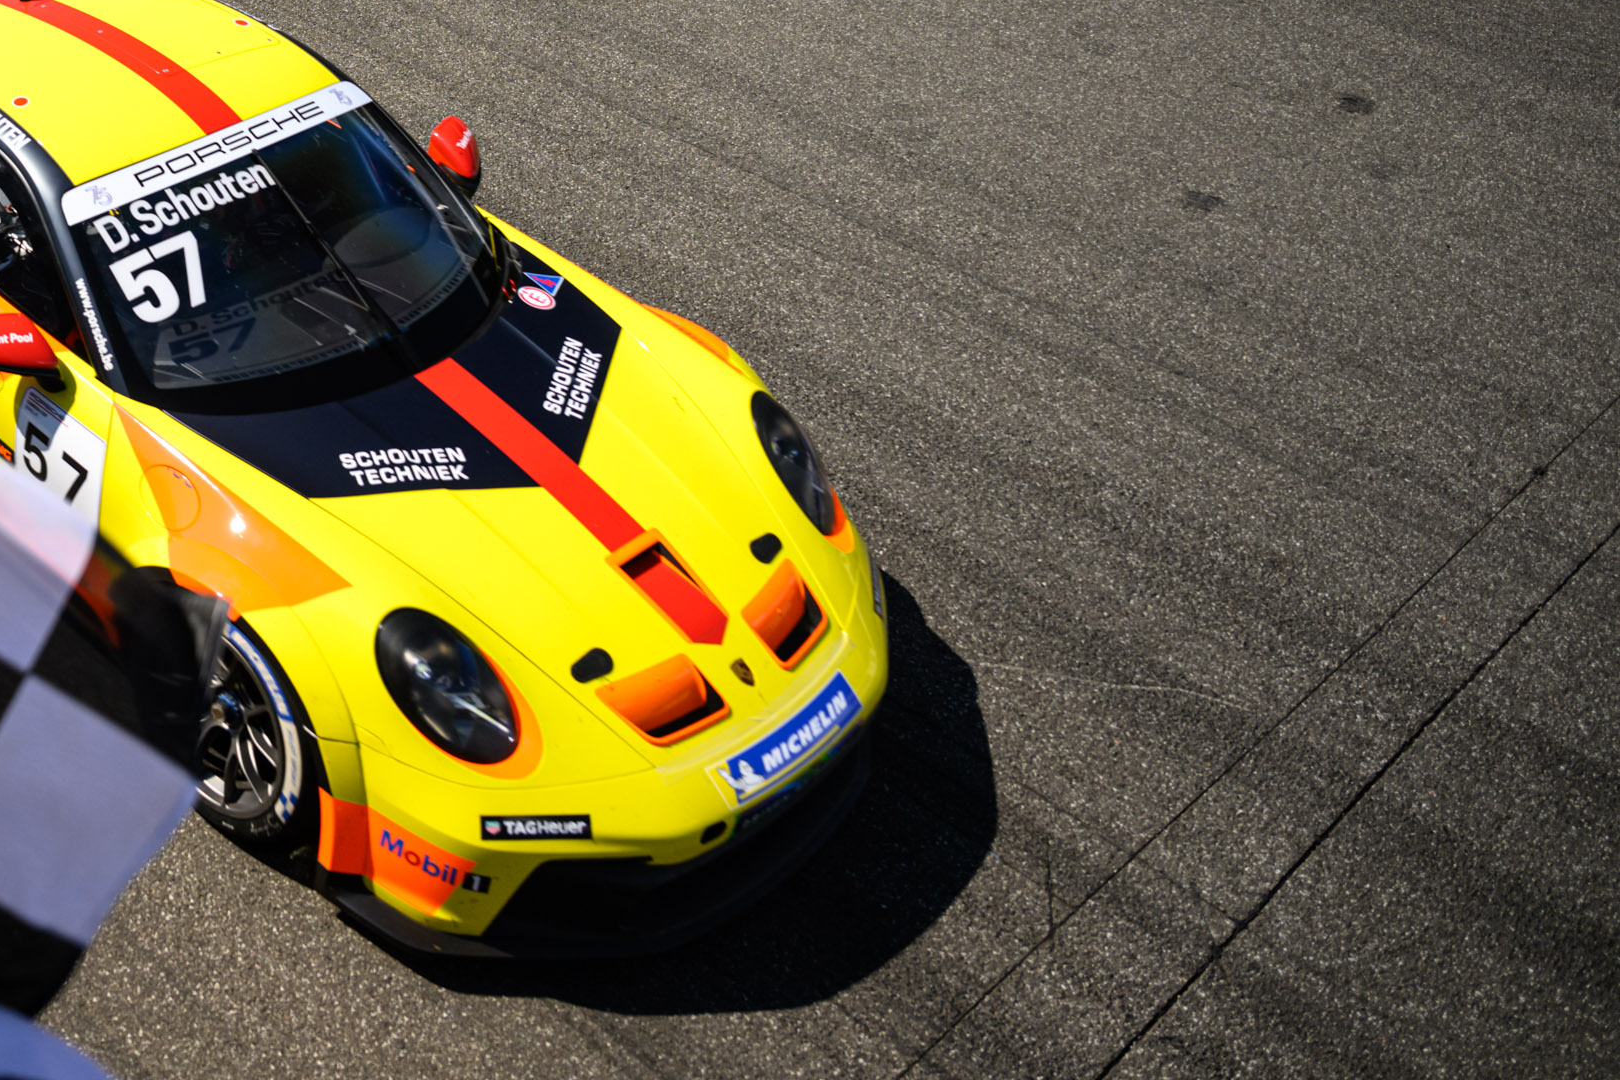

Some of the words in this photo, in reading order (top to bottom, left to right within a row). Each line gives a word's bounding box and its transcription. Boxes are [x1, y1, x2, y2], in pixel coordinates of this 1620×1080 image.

[133, 100, 324, 187] PORSCHE
[92, 213, 141, 254] D.
[129, 163, 277, 236] Schouten
[108, 230, 207, 323] 57
[10, 332, 33, 344] Pool
[74, 277, 114, 372] www.porsche.be
[542, 336, 583, 415] SCHOUTEN
[564, 348, 603, 420] TECHNIEK
[23, 421, 88, 506] 57
[338, 446, 467, 470] SCHOUTEN
[349, 464, 469, 487] TECHNIEK
[761, 690, 848, 774] MICHELIN
[380, 828, 458, 886] Mobil
[471, 875, 481, 891] 1
